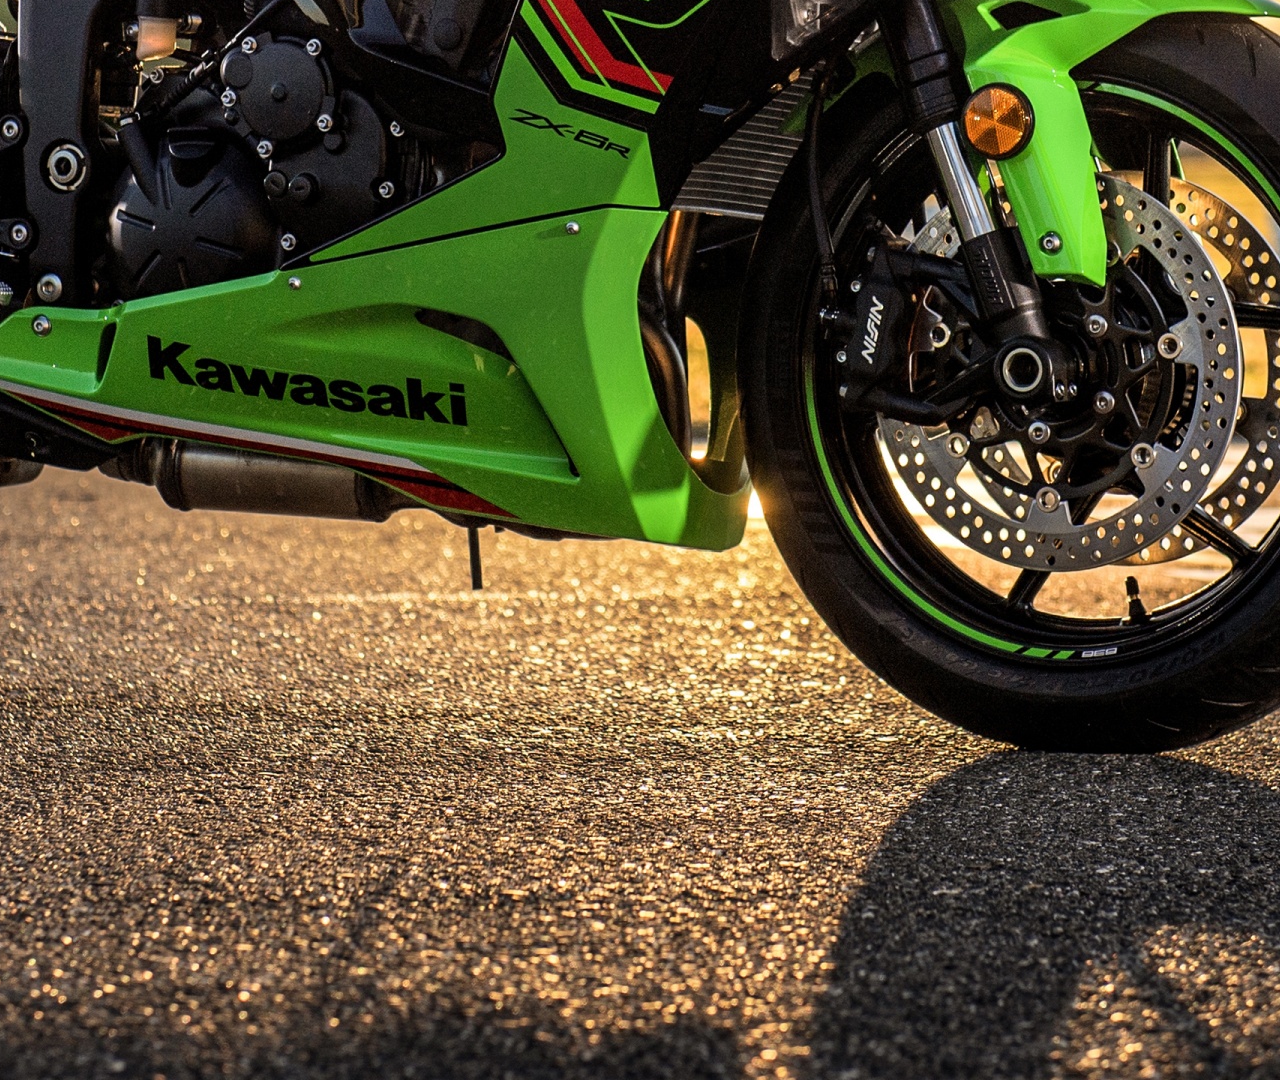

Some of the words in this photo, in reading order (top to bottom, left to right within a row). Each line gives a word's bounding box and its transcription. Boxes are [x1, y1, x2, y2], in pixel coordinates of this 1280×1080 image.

[508, 108, 631, 160] ZX-6R
[861, 295, 884, 365] NISSIN
[146, 334, 468, 427] Kawasaki
